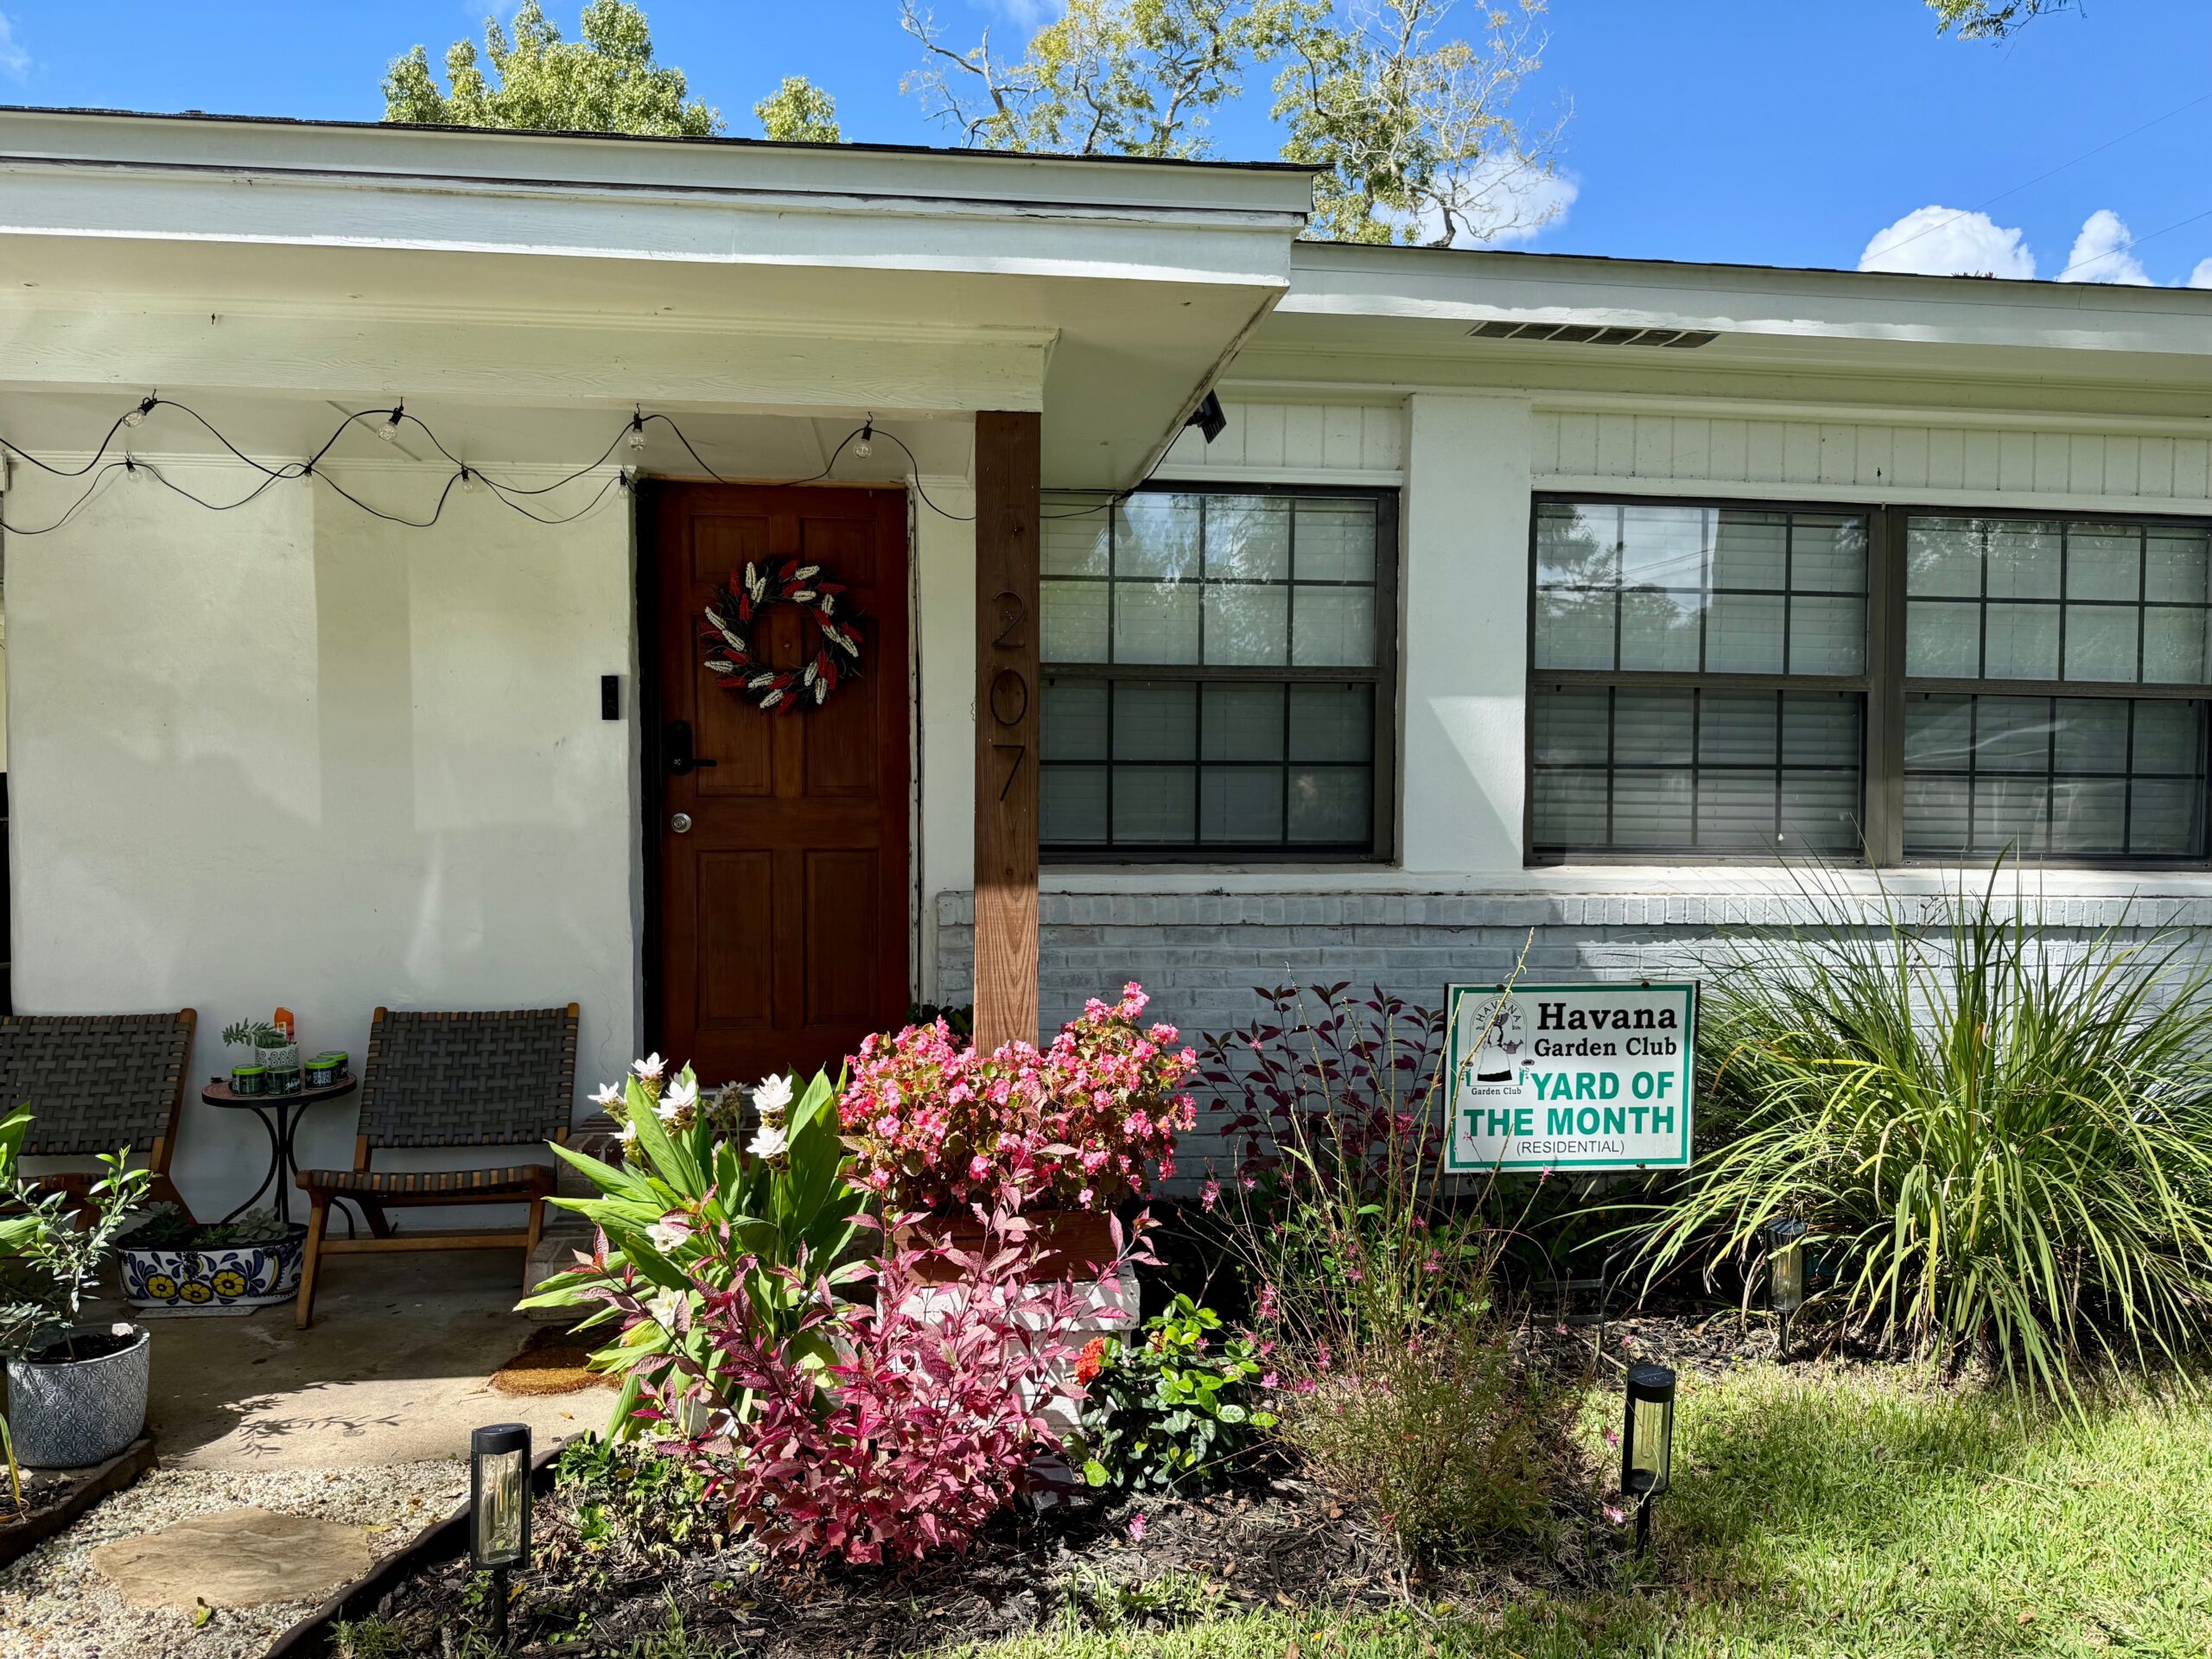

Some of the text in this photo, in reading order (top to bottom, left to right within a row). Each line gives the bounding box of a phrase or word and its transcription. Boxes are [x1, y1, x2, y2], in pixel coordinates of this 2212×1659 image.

[990, 589, 1028, 802] 207
[1537, 1002, 1677, 1030] Havana
[1535, 1037, 1677, 1057] Garden Club
[1471, 1087, 1501, 1096] Garden
[1530, 1071, 1675, 1100] YARD OF
[1464, 1107, 1674, 1136] THE MONTH
[1516, 1141, 1624, 1157] (RESIDENTIAL)
